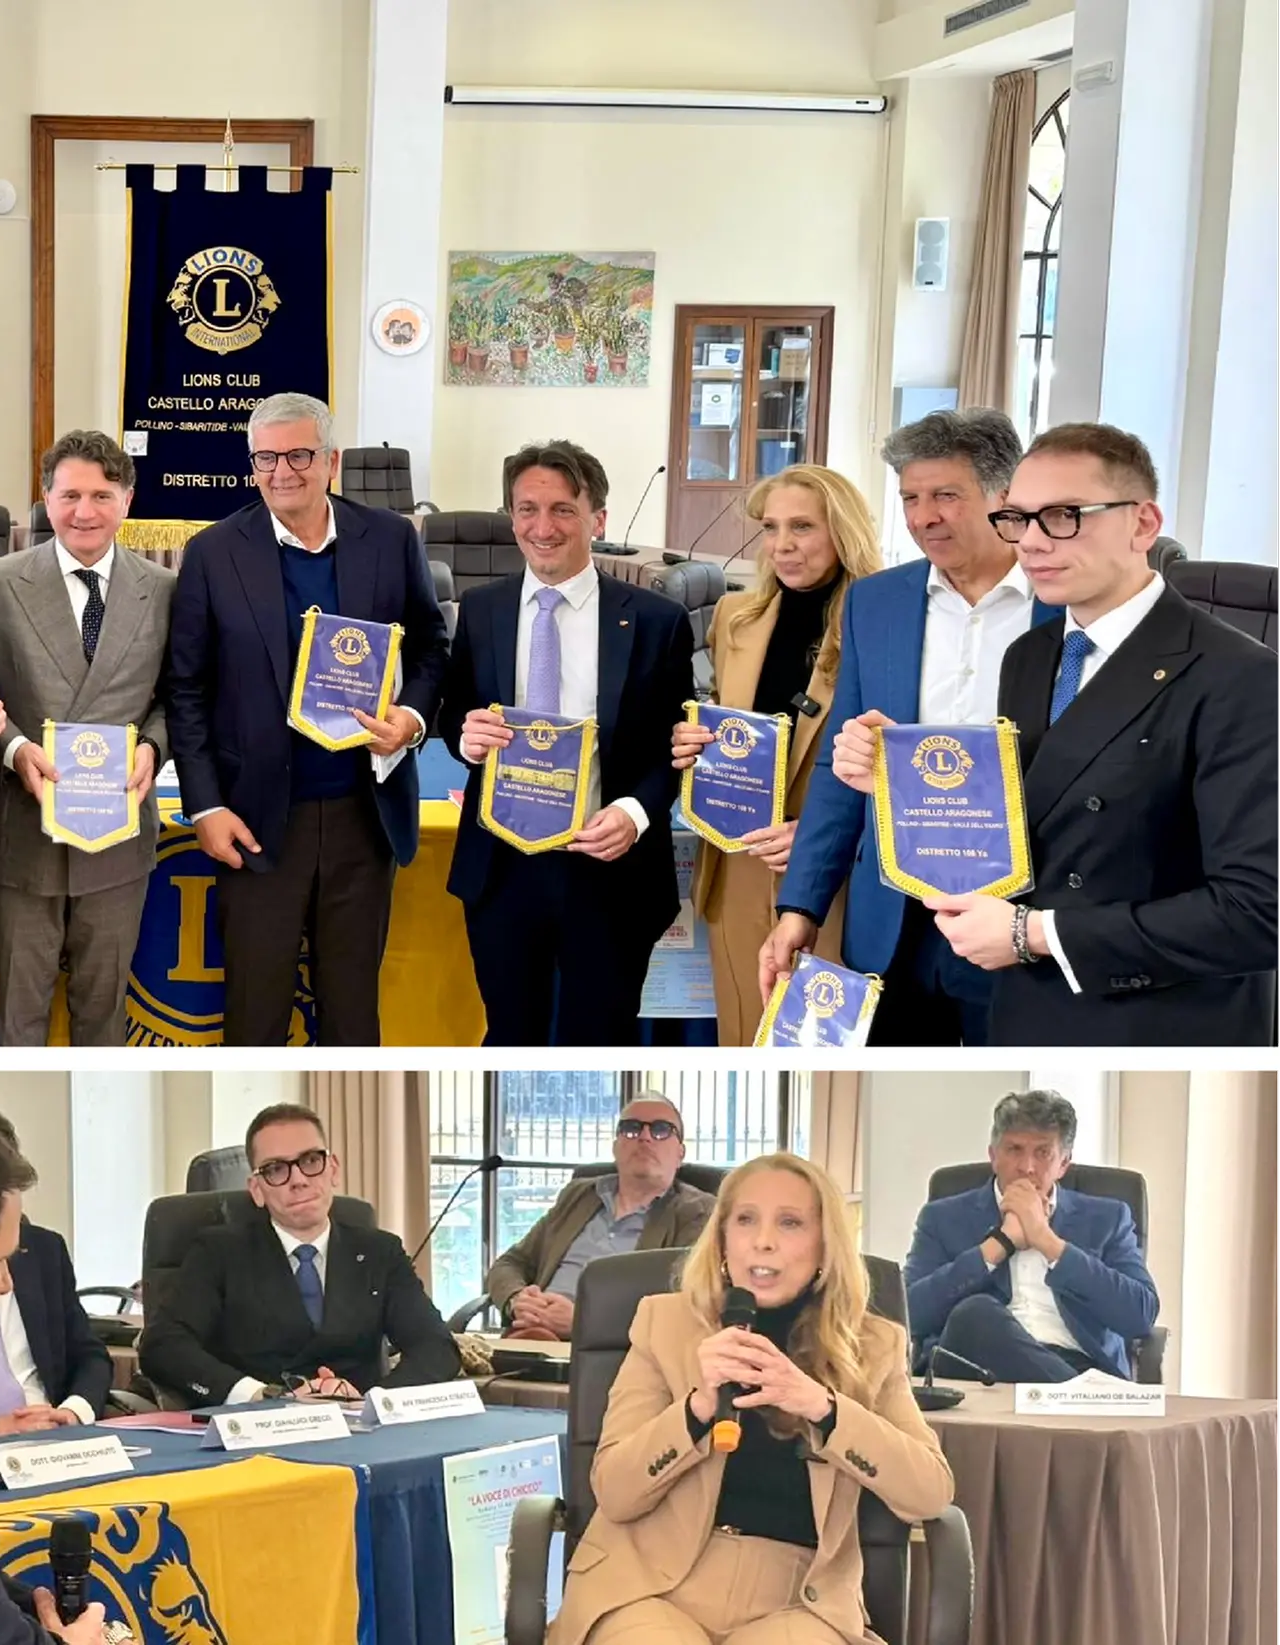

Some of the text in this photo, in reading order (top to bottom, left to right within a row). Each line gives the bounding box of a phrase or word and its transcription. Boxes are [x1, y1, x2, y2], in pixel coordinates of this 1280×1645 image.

[192, 249, 258, 274] LIONS
[212, 279, 241, 317] L
[190, 327, 259, 348] INTERNATIONAL
[183, 374, 260, 387] LIONS CLUB
[148, 396, 214, 410] CASTELLO
[135, 420, 174, 430] POLLINO
[179, 422, 227, 432] SIBARITIDE
[163, 473, 259, 487] DISTRETTO 10
[345, 638, 357, 653] L
[730, 730, 742, 746] L
[923, 737, 957, 748] LIONS
[86, 743, 96, 756] L
[934, 752, 952, 770] L
[923, 796, 968, 805] LIONS CLUB
[903, 808, 993, 818] CASTELLO ARAGONESE
[916, 847, 960, 857] DISTRETTO
[817, 985, 830, 1004] L
[1071, 1392, 1111, 1400] VITALIANO
[1113, 1392, 1124, 1400] DE
[1126, 1392, 1161, 1400] SALAZAR
[482, 1489, 502, 1502] VOCE
